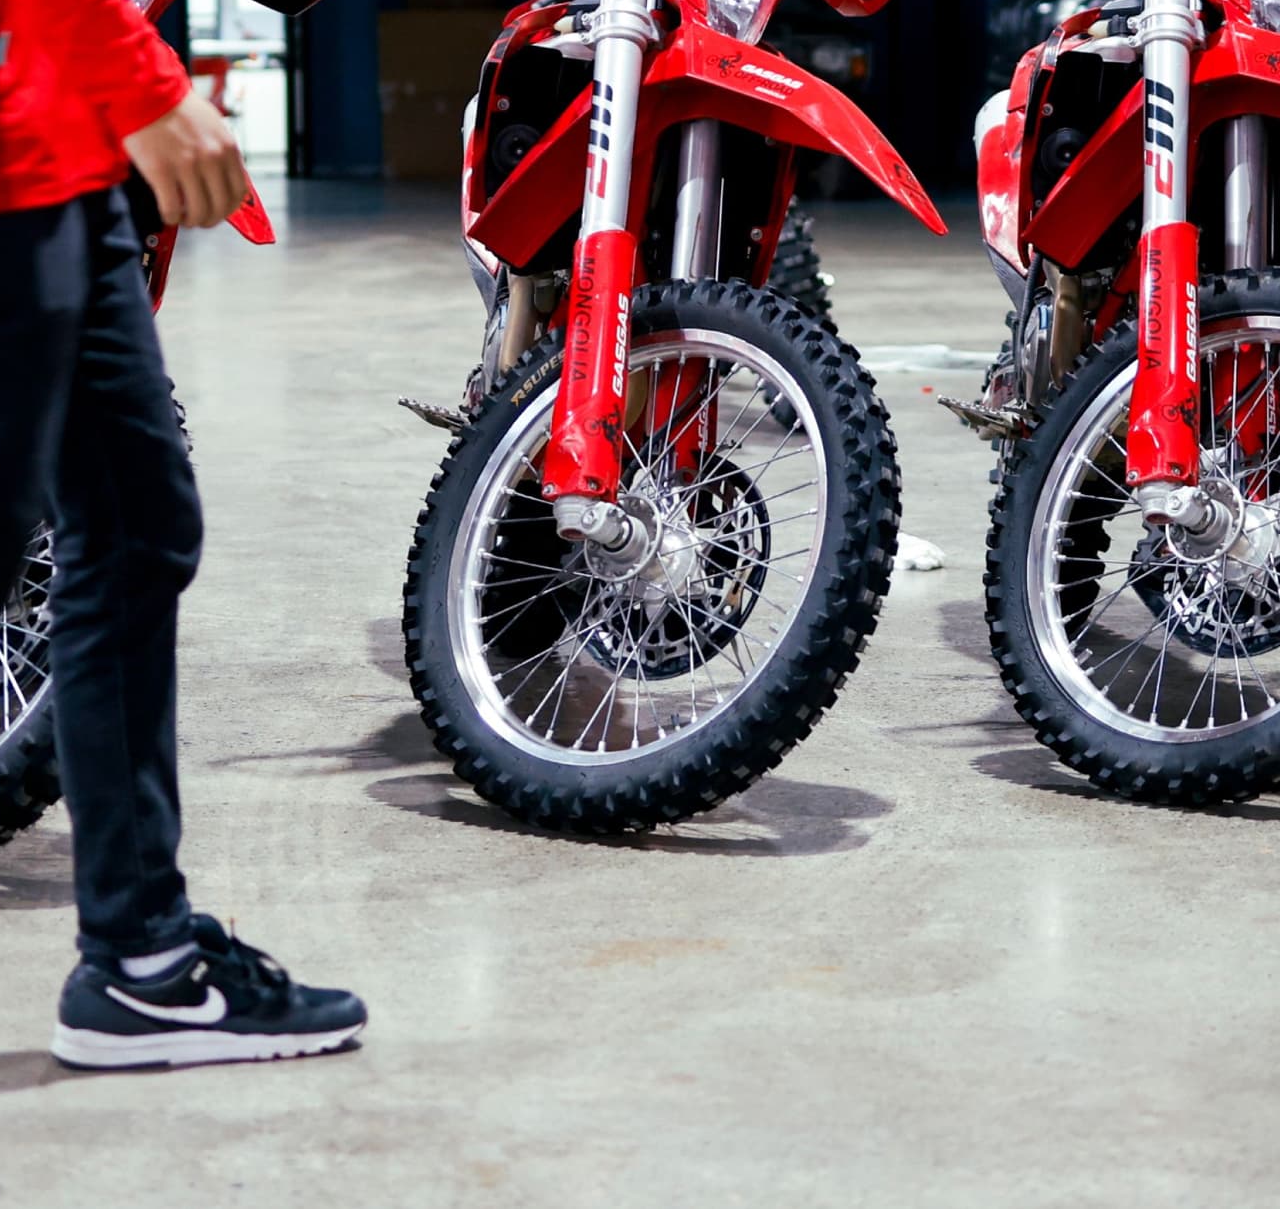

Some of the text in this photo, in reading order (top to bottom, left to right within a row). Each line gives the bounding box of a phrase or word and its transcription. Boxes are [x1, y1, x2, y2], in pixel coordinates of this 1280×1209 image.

[740, 63, 805, 90] GASGAS
[1144, 78, 1174, 200] WP
[611, 292, 630, 398] GASGAS
[1144, 249, 1162, 371] MONGOLIA
[1186, 282, 1197, 382] GASGAS
